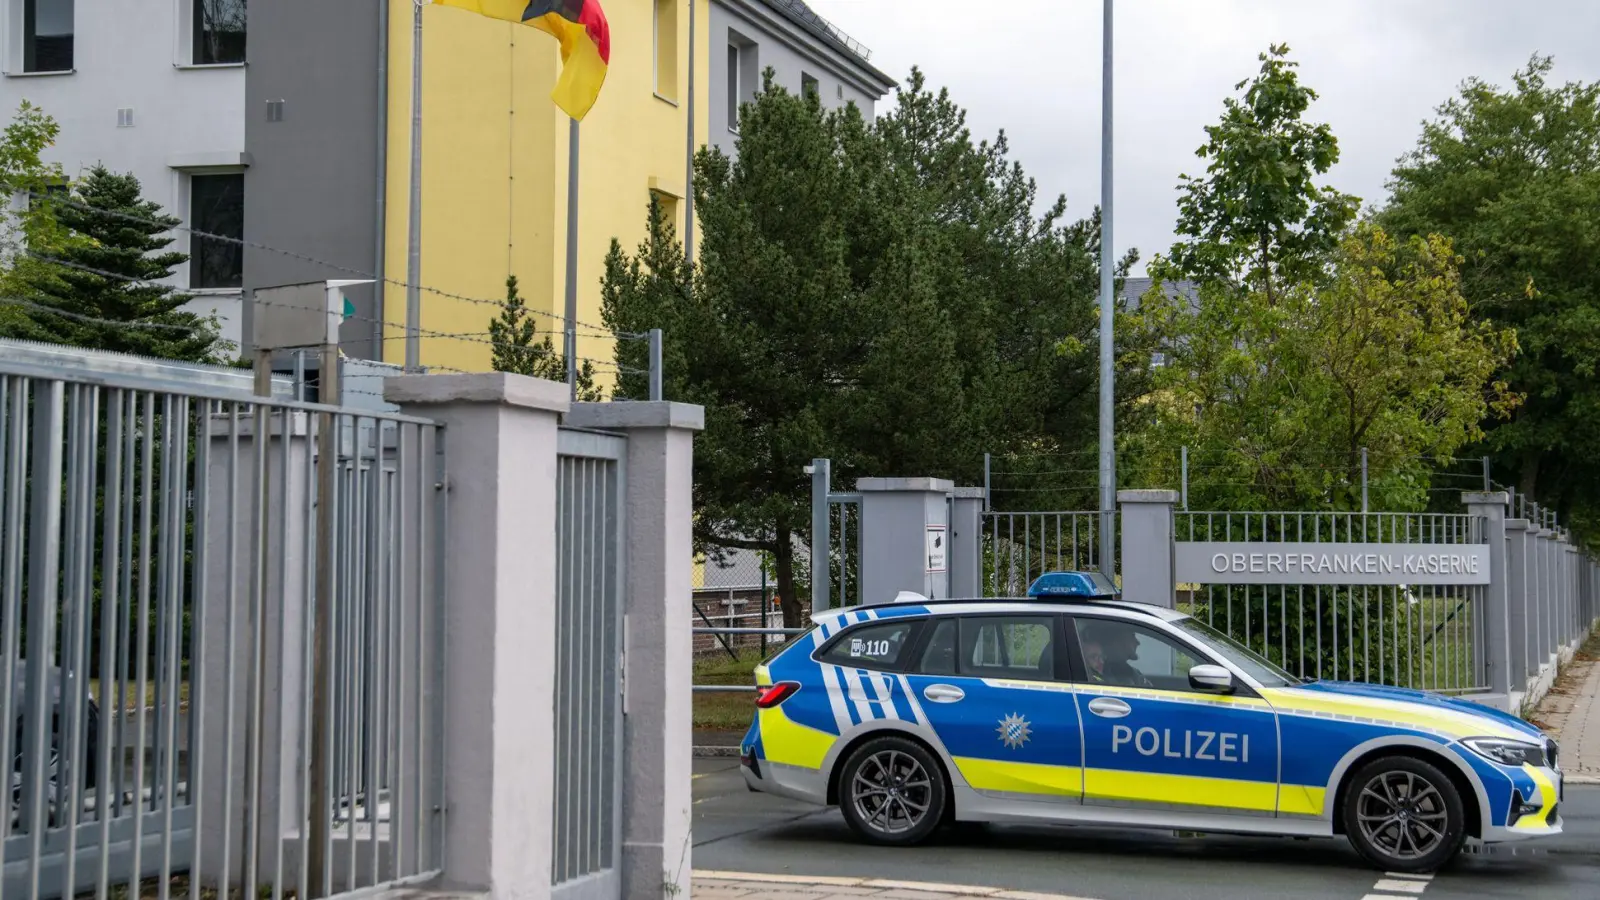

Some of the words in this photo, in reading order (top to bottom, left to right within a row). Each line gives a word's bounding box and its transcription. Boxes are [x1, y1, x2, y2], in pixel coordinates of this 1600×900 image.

[1211, 553, 1479, 576] OBERFRANKEN-KASERNE
[866, 640, 889, 656] 110
[1112, 724, 1249, 763] POLIZEI
